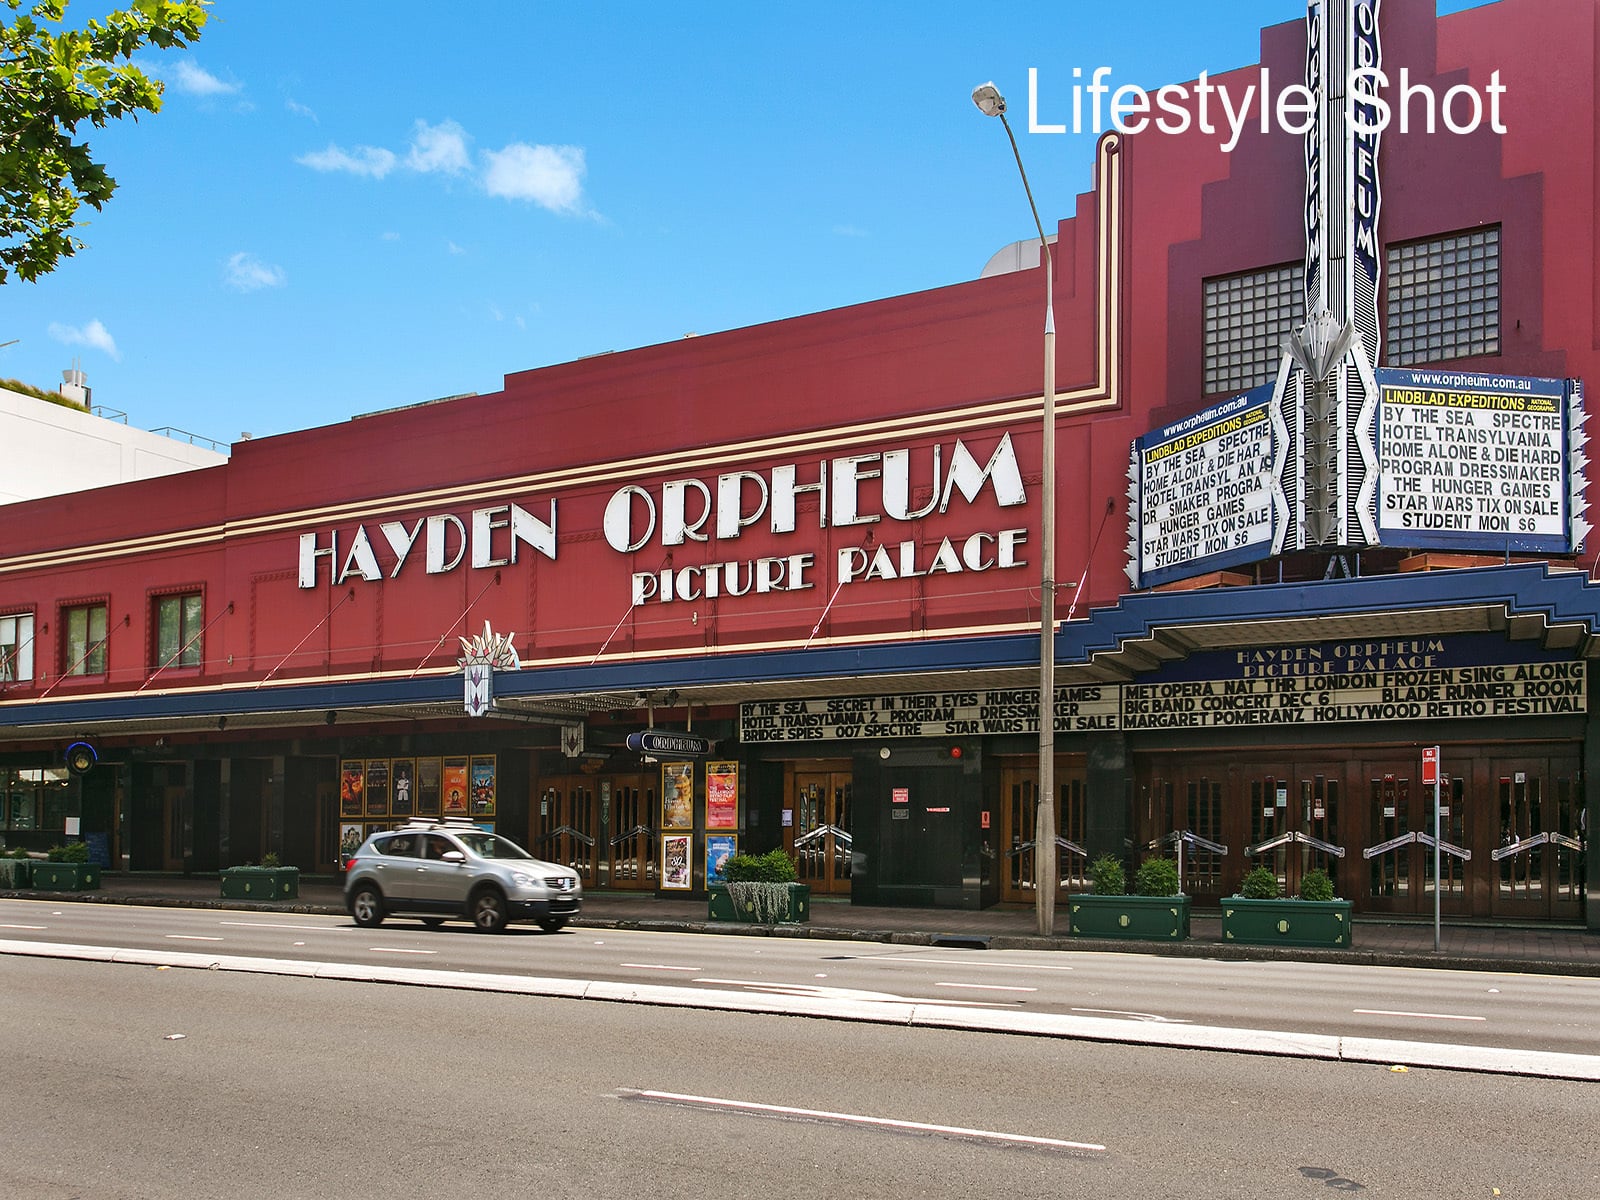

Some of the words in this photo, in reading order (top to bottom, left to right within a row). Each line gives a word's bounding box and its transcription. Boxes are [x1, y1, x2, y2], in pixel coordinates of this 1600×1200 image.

[1411, 373, 1531, 390] www.orpheum.com.au
[1386, 390, 1446, 406] LINDBLAD
[1449, 393, 1525, 411] EXPEDITIONS
[1163, 395, 1248, 437] www.orpheum.com.au
[1384, 407, 1404, 421] BY
[1412, 408, 1438, 423] THE
[1445, 411, 1474, 426] SEA
[1492, 413, 1560, 431] SPECTRE
[1147, 434, 1185, 463] LINDBLAD
[1186, 417, 1242, 446] EXPEDITIONS
[1383, 424, 1431, 441] HOTEL
[1435, 427, 1551, 448] TRANSYLVANIA
[1146, 464, 1160, 480] BY
[1163, 456, 1181, 475] THE
[1185, 446, 1206, 465] SEA
[1218, 422, 1270, 453] SPECTRE
[1382, 442, 1423, 458] HOME
[1428, 444, 1477, 460] ALONE
[1481, 447, 1491, 462] &
[1495, 448, 1518, 463] DIE
[1521, 449, 1560, 465] HARD
[1144, 474, 1169, 495] HOME
[1207, 457, 1215, 471] &
[1217, 449, 1234, 470] DIE
[1381, 459, 1453, 476] PROGRAM
[1460, 463, 1560, 481] DRESSMAKER
[1147, 488, 1177, 509] HOTEL
[1169, 492, 1210, 517] SMAKER
[1217, 476, 1262, 503] PROGRA
[1394, 477, 1421, 492] THE
[1432, 479, 1492, 495] HUNGER
[1501, 482, 1551, 498] GAMES
[298, 497, 557, 589] HAYDEN
[603, 431, 1027, 553] ORPHEUM
[1160, 512, 1199, 536] HUNGER
[1207, 497, 1245, 521] GAMES
[1386, 494, 1427, 510] STAR
[1432, 496, 1473, 511] WARS
[1477, 498, 1500, 512] TIX
[1504, 500, 1521, 514] ON
[1524, 500, 1558, 515] SALE
[1145, 537, 1169, 555] STAR
[1171, 527, 1200, 548] WARS
[1202, 523, 1218, 540] TIX
[1222, 518, 1235, 534] ON
[1237, 507, 1268, 529] SALE
[1402, 512, 1472, 529] STUDENT
[1479, 516, 1510, 531] MON
[1519, 518, 1536, 531] $6
[1155, 543, 1199, 567] STUDENT
[1205, 536, 1228, 554] MON
[1234, 531, 1248, 545] $6
[632, 553, 814, 606] PICTURE
[838, 528, 1028, 584] PALACE
[1237, 647, 1322, 664] HAYDEN
[1334, 639, 1445, 658] ORPHEUM
[1243, 661, 1335, 678] PICTURE
[1347, 655, 1437, 672] PALACE
[1125, 684, 1159, 699] MET
[1161, 682, 1214, 698] OPERA
[1224, 680, 1256, 695] NAT
[1265, 677, 1296, 693] THR
[1304, 673, 1377, 691] LONDON
[1384, 669, 1453, 687] FROZEN
[1459, 667, 1505, 684] SING
[1514, 663, 1583, 681] ALONG
[742, 704, 756, 717] BY
[759, 703, 780, 715] THE
[784, 701, 808, 714] SEA
[827, 699, 875, 713] SECRET
[882, 697, 894, 710] IN
[900, 695, 937, 709] THEIR
[942, 693, 978, 707] EYES
[986, 690, 1041, 706] HUNGER
[1125, 700, 1149, 714] BIG
[1152, 698, 1195, 713] BAND
[1201, 694, 1273, 711] CONCERT
[1279, 692, 1311, 708] DEC
[1318, 691, 1329, 705] 6
[1382, 686, 1440, 703] BLADE
[1445, 682, 1515, 700] RUNNER
[1523, 679, 1582, 697] ROOM
[742, 717, 777, 729] HOTEL
[779, 711, 865, 728] TRANSYLVANIA
[870, 711, 878, 723] 2
[890, 708, 955, 722] PROGRAM
[980, 703, 1079, 719] DRESSMKER
[1123, 711, 1209, 728] MARGARET
[1213, 708, 1304, 726] POMERANZ
[1313, 704, 1421, 722] HOLLYWOOD
[1426, 700, 1486, 718] RETRO
[1493, 697, 1585, 714] FESTIVAL
[743, 729, 784, 741] BRIDGE
[788, 727, 823, 740] SPIES
[836, 725, 861, 738] 007
[864, 723, 922, 737] SPECTRE
[945, 720, 979, 734] STAR
[983, 719, 1023, 732] WARS
[1026, 718, 1041, 732] TI
[1053, 717, 1071, 730] ON
[1077, 715, 1116, 730] SALE
